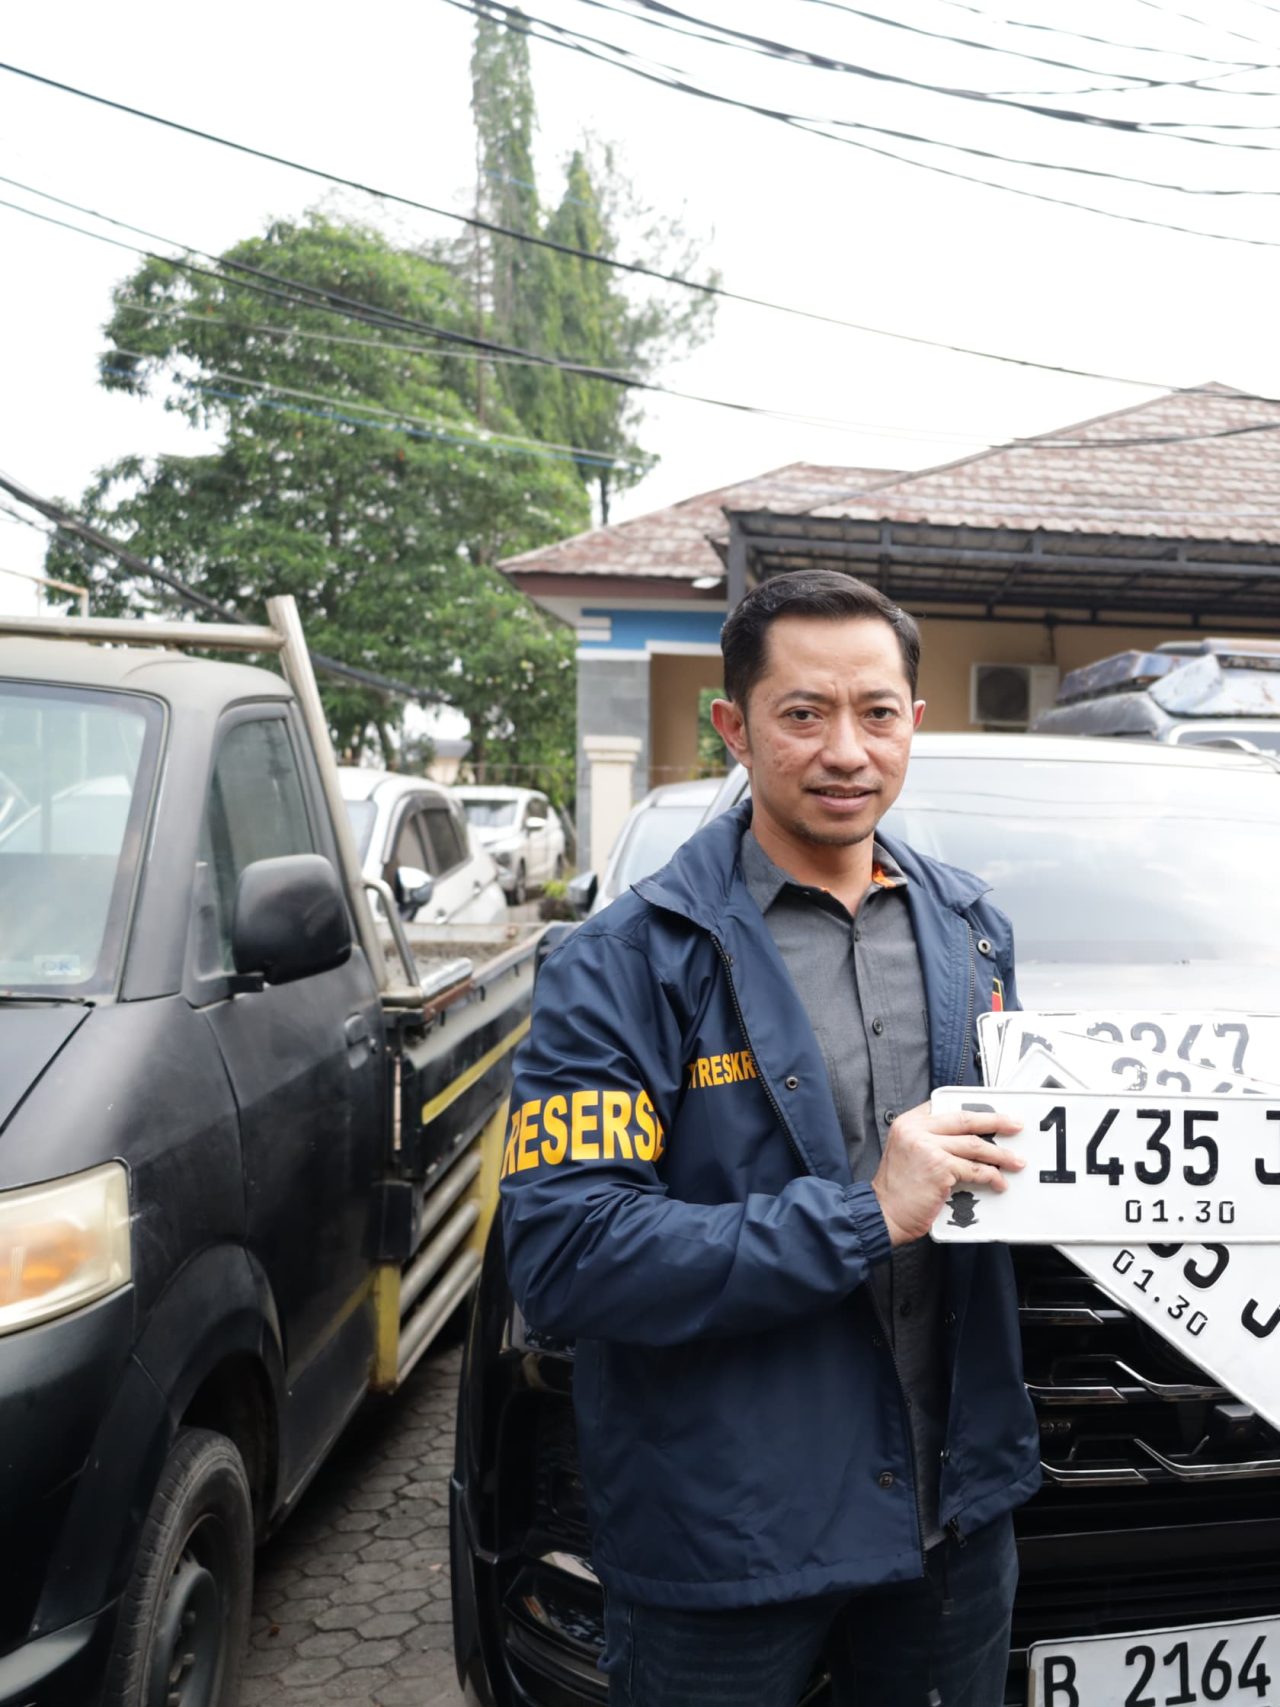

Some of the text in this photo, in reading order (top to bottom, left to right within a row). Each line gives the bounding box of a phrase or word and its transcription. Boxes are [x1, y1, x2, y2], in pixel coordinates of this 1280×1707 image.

[1039, 1106, 1220, 1187] 1435
[1125, 1199, 1236, 1225] 01.30
[1112, 1249, 1209, 1337] 01.30
[1043, 1655, 1080, 1707] B
[1124, 1635, 1272, 1707] 2164
